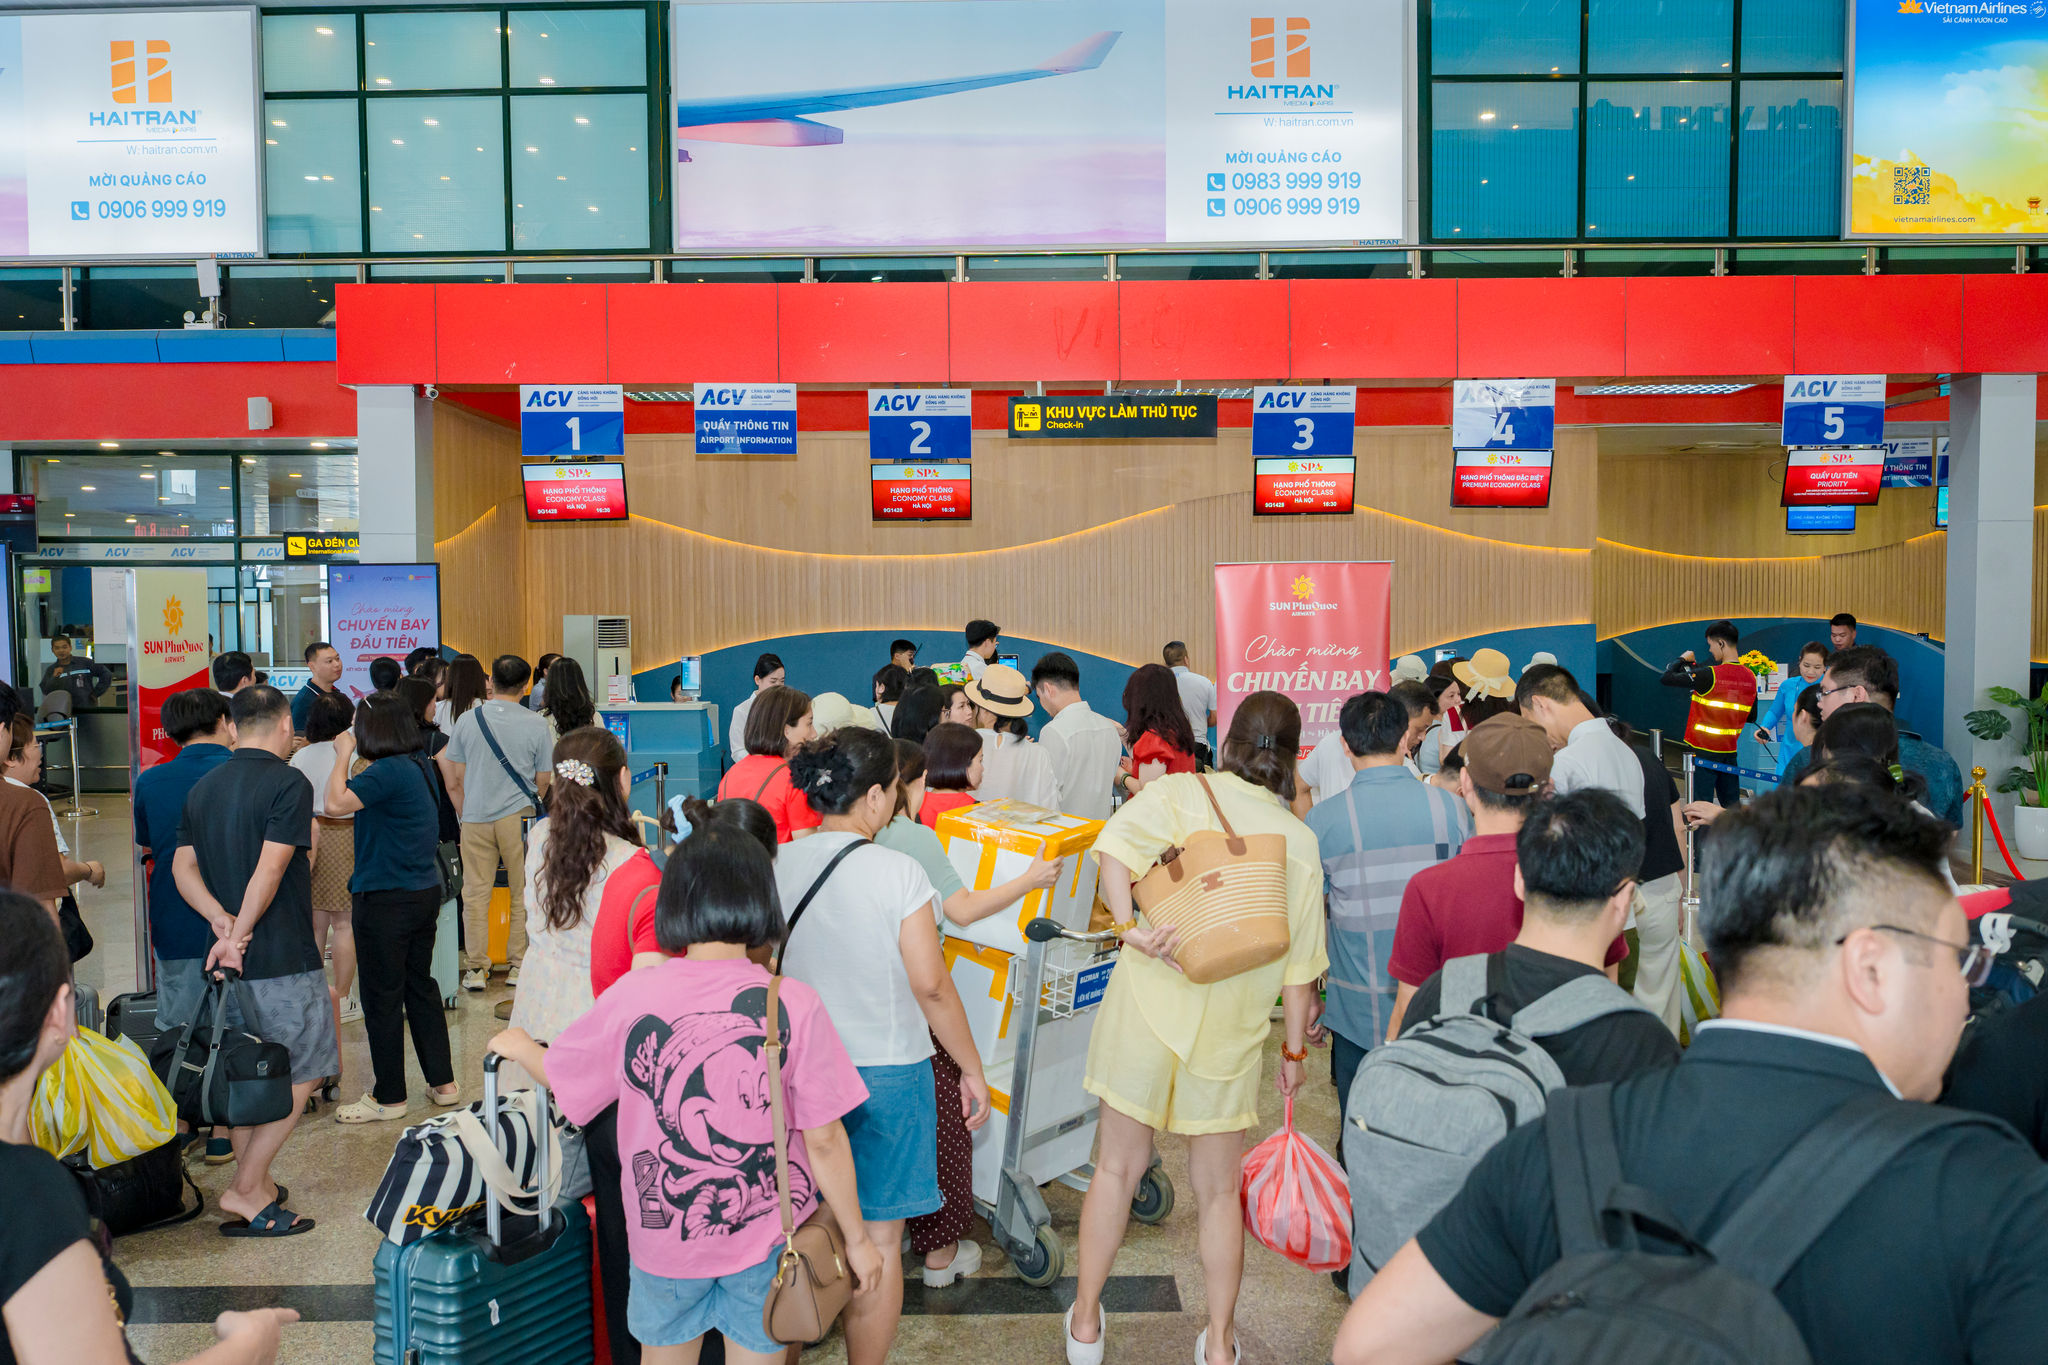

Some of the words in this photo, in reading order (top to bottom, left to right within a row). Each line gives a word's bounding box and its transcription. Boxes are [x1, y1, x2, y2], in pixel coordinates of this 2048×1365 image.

[1924, 1, 1978, 14] Vietnam
[1979, 1, 2027, 14] Airlines
[1264, 117, 1277, 127] W:
[1279, 117, 1354, 127] haitran.com.vn
[127, 145, 141, 155] W:
[142, 144, 218, 155] haitran.com.vn
[1226, 150, 1253, 164] MỜI
[1257, 149, 1308, 164] QUẢNG
[1311, 149, 1342, 163] CÁO
[89, 172, 116, 187] MỜI
[120, 171, 172, 187] QUẢNG
[176, 171, 206, 186] CÁO
[1232, 172, 1280, 190] 0983
[1286, 172, 1322, 189] 999
[1328, 172, 1361, 189] 919
[98, 200, 146, 219] 0906
[152, 200, 188, 218] 999
[193, 199, 226, 218] 919
[1234, 198, 1282, 215] 0906
[1287, 198, 1323, 215] 999
[1327, 197, 1360, 215] 919
[1790, 381, 1838, 398] ACV
[526, 390, 573, 407] ACV
[700, 389, 747, 406] ACV
[874, 394, 921, 411] ACV
[1259, 392, 1307, 408] ACV
[1046, 406, 1074, 419] KHU
[1077, 405, 1106, 421] VỰC
[1109, 403, 1138, 418] LÀM
[1141, 403, 1168, 418] THỦ
[1172, 405, 1198, 420] TỤC
[733, 419, 769, 430] THÔNG
[771, 421, 789, 430] TIN
[1046, 420, 1084, 429] Check-in
[1492, 412, 1515, 445] 4
[1823, 407, 1845, 440] 5
[565, 416, 580, 451] 1
[910, 421, 931, 454] 2
[1292, 417, 1315, 450] 3
[700, 436, 735, 444] AIRPORT
[736, 436, 793, 444] INFORMATION
[1499, 454, 1522, 464] SPA
[1832, 454, 1855, 463] SPA
[568, 468, 591, 478] SPA
[916, 468, 940, 478] SPA
[1300, 462, 1324, 472] SPA
[1890, 463, 1913, 471] THÔNG
[1461, 474, 1479, 482] HẠNG
[543, 488, 564, 496] HẠNG
[581, 486, 607, 494] THÔNG
[890, 487, 911, 495] HẠNG
[1275, 489, 1310, 497] ECONOMY
[308, 538, 324, 548] GA
[347, 538, 360, 549] QU
[39, 547, 65, 557] ACV
[105, 547, 130, 557] ACV
[171, 547, 196, 557] ACV
[257, 547, 282, 557] ACV
[1269, 602, 1291, 611] SUN
[1292, 601, 1338, 611] PhuQuoc
[337, 615, 397, 631] CHUYẾN
[400, 618, 431, 631] BAY
[144, 639, 164, 655] SUN
[164, 639, 204, 654] PhuQuoc
[386, 634, 418, 649] TIÊN
[1245, 634, 1301, 663] Chào
[1306, 642, 1362, 660] mừng
[164, 655, 185, 664] AIRWAYS
[268, 675, 298, 687] ACV
[1227, 660, 1326, 693] CHUYẾN
[1329, 669, 1382, 691] BAY
[1306, 697, 1342, 723] TIÊ
